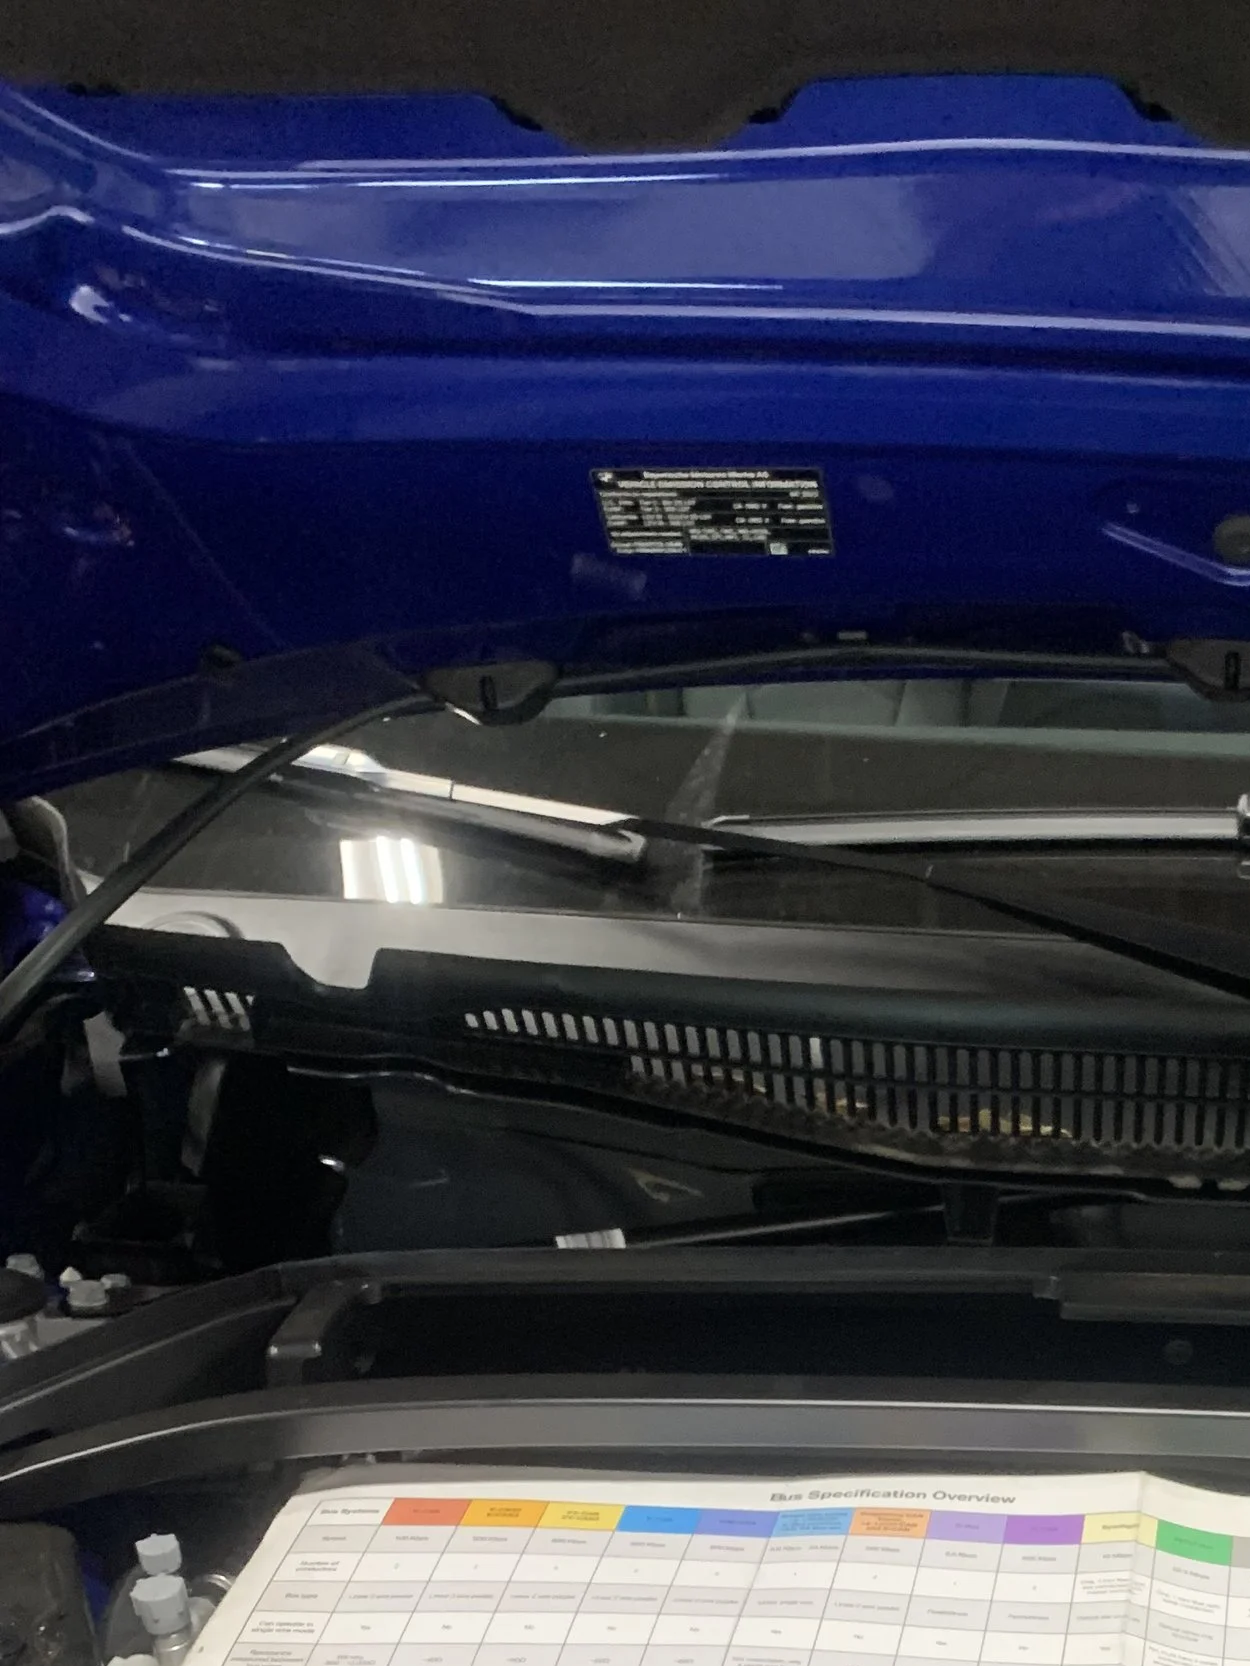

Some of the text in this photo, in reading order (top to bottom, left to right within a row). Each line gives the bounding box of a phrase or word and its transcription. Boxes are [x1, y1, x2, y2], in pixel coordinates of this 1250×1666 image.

[770, 1489, 1016, 1504] Bus Specification Overview
